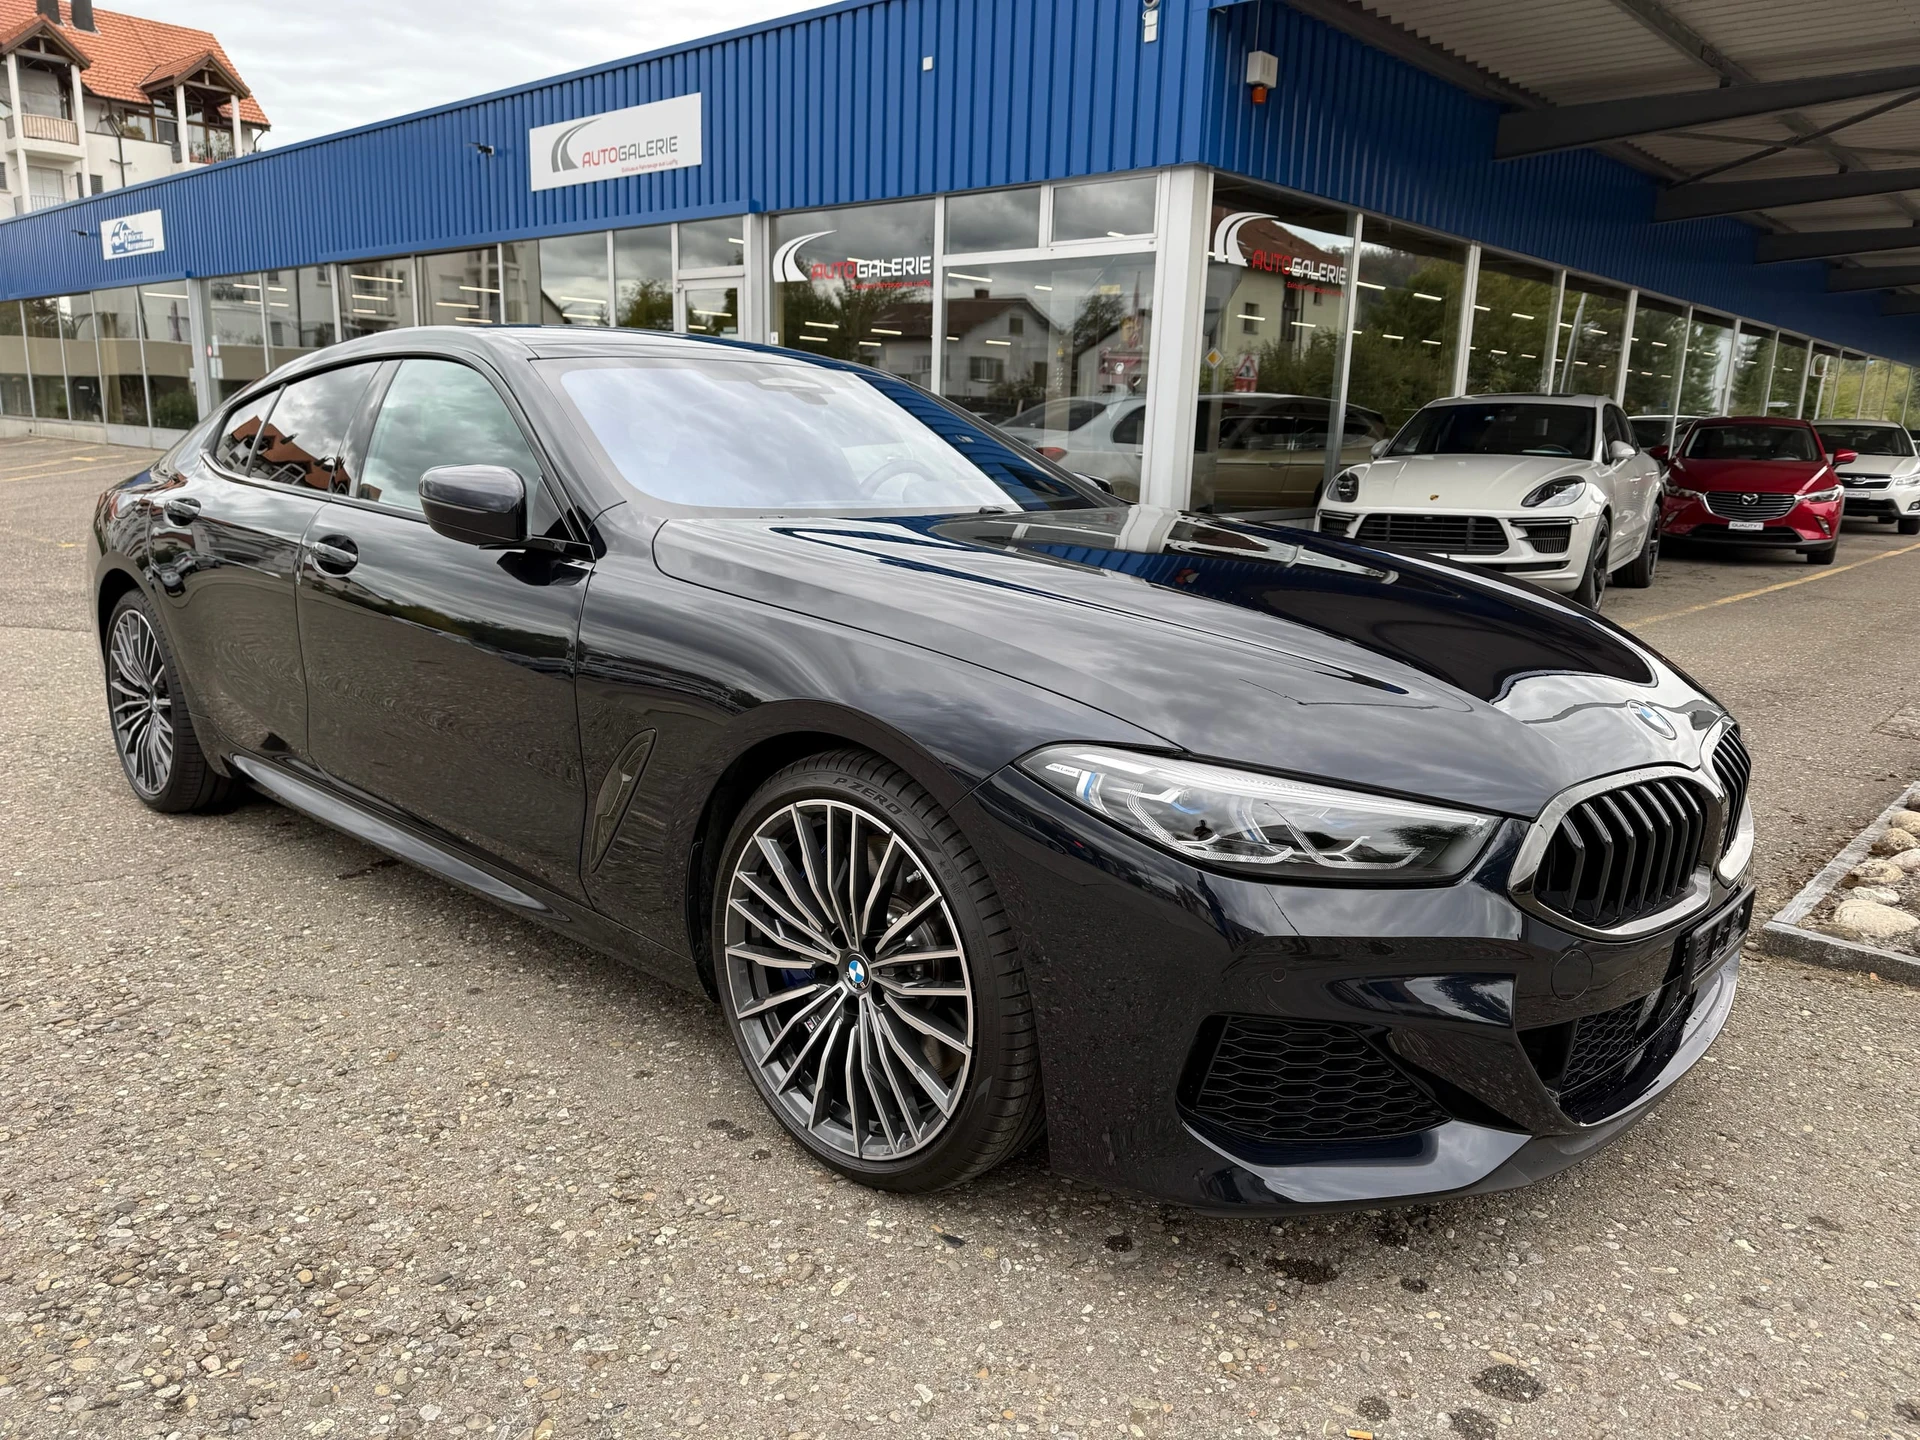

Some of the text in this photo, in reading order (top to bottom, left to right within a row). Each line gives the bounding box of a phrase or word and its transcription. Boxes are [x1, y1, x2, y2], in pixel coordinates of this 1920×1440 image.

[582, 135, 678, 168] AUTOGALERIE
[811, 255, 931, 281] AUTOGALERIE
[1252, 249, 1347, 285] AUTOGALERIE
[848, 781, 903, 815] ZERO
